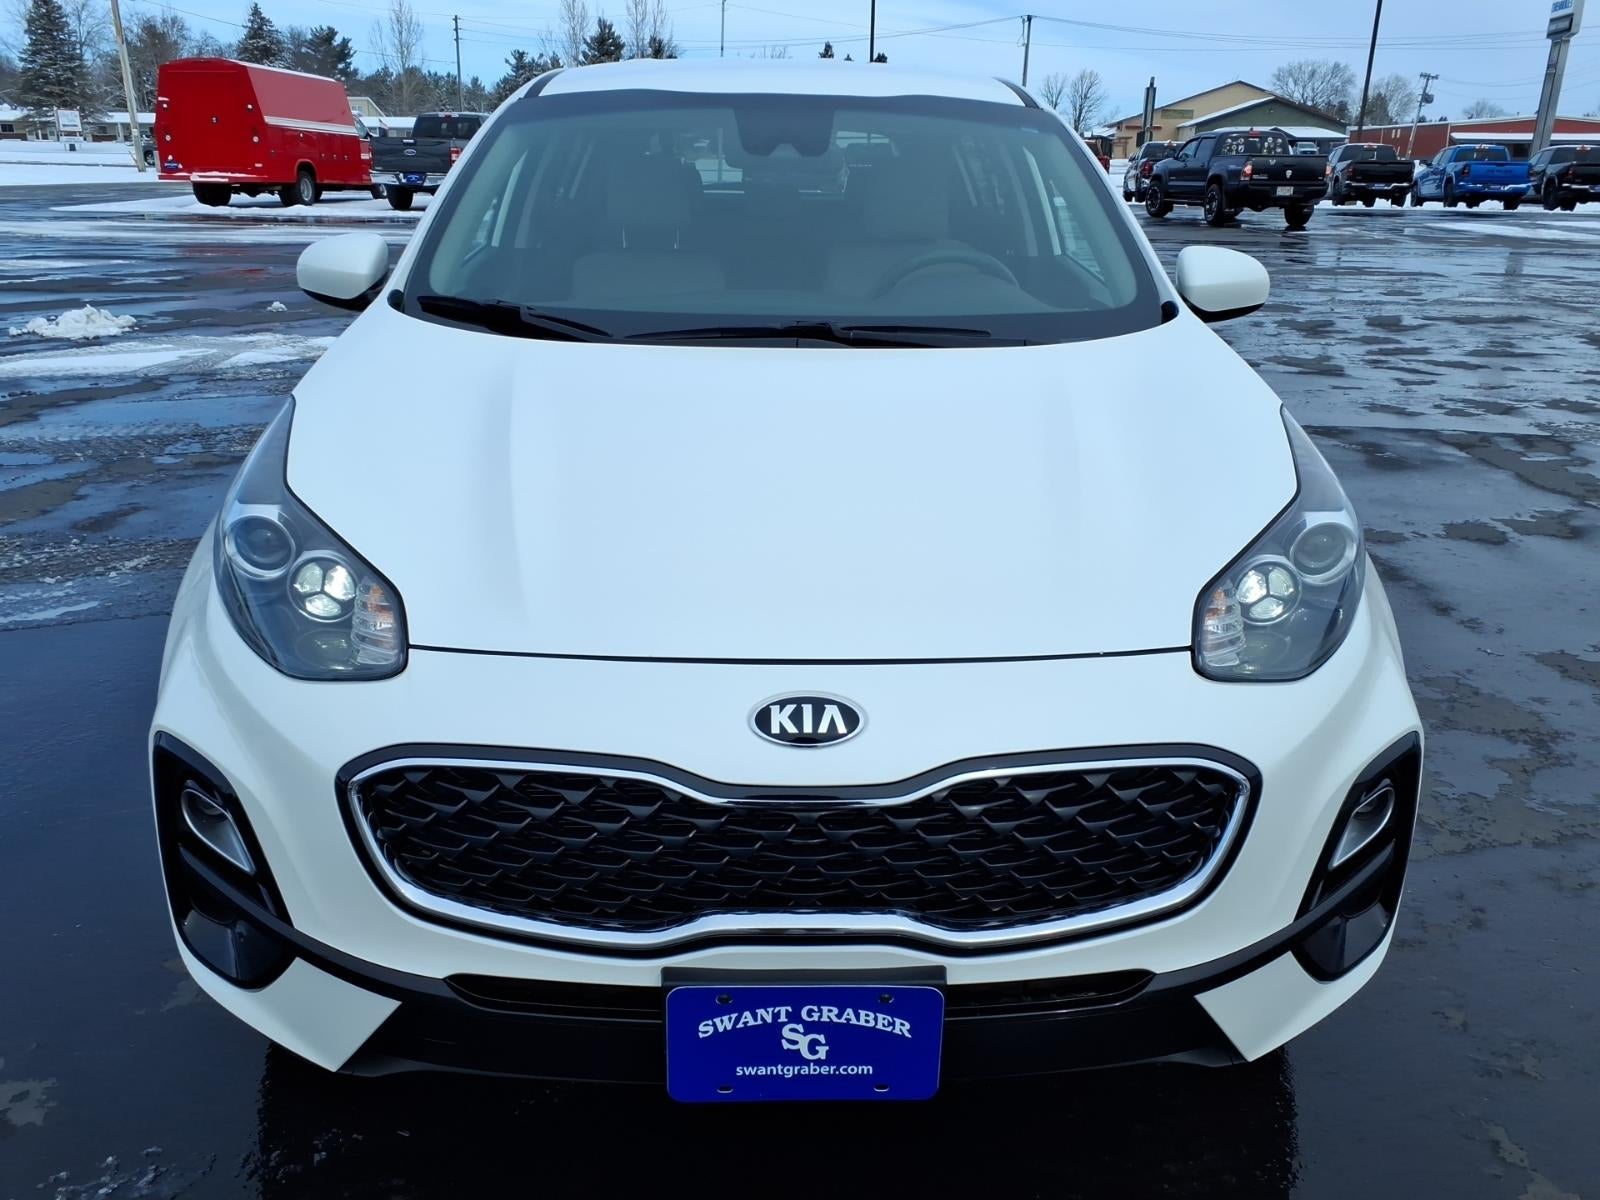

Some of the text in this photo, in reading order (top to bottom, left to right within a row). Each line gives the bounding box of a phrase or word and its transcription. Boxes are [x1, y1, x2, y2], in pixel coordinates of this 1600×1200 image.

[769, 704, 847, 734] KIA
[698, 1005, 912, 1039] SWANT GRABER
[781, 1023, 829, 1060] SG
[735, 1063, 873, 1078] swantgraber.com
